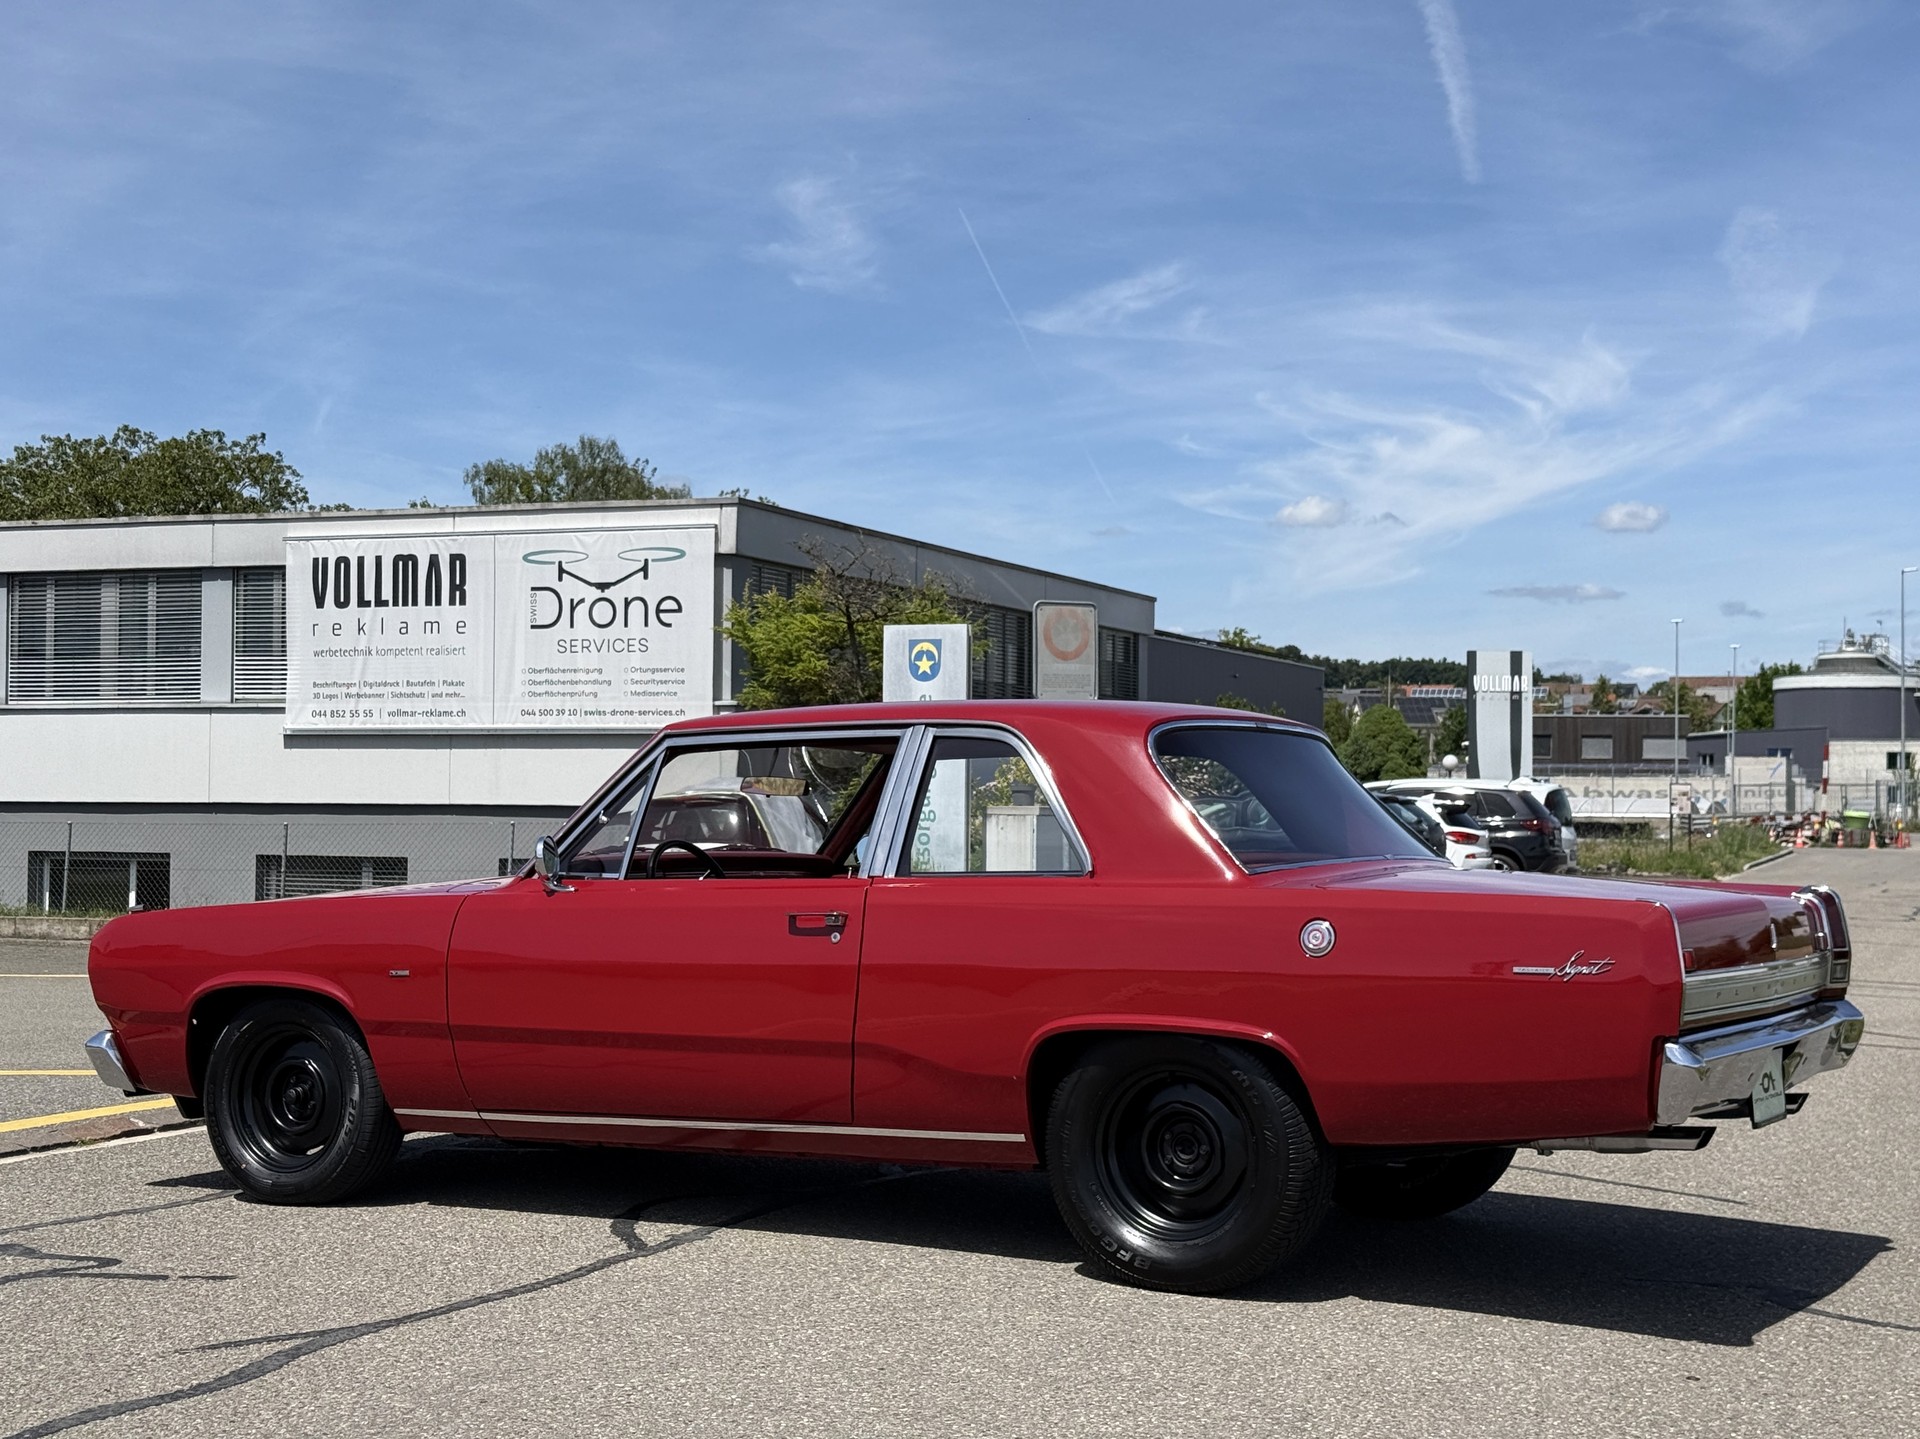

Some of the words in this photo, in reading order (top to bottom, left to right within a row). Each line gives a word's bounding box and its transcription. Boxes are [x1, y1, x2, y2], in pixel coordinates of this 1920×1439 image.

[312, 553, 467, 609] VOLLMAR
[530, 592, 538, 624] SWISS
[530, 587, 683, 630] Drone
[312, 617, 467, 637] reklame
[313, 646, 373, 658] werbetechnik
[375, 646, 424, 658] kompetent
[425, 645, 466, 656] realisiert
[557, 638, 649, 654] SERVICES
[630, 666, 685, 674] Ortungsservice
[312, 681, 357, 689] Beschriftungen
[363, 680, 400, 689] Digitaldruck
[630, 678, 686, 686] Securityservice
[1473, 674, 1529, 693] VOLLMAR
[322, 693, 339, 701] Logos
[390, 691, 426, 699] Sichtschutz
[311, 709, 327, 718] 044
[330, 709, 346, 718] 852
[349, 709, 360, 718] 55
[363, 708, 374, 718] 55
[387, 708, 467, 718] vollmar-reklame.ch
[520, 709, 537, 717] 044
[538, 709, 554, 717] 500
[555, 709, 566, 717] 39
[567, 709, 578, 717] 10
[583, 708, 686, 717] swiss-drone-services.ch
